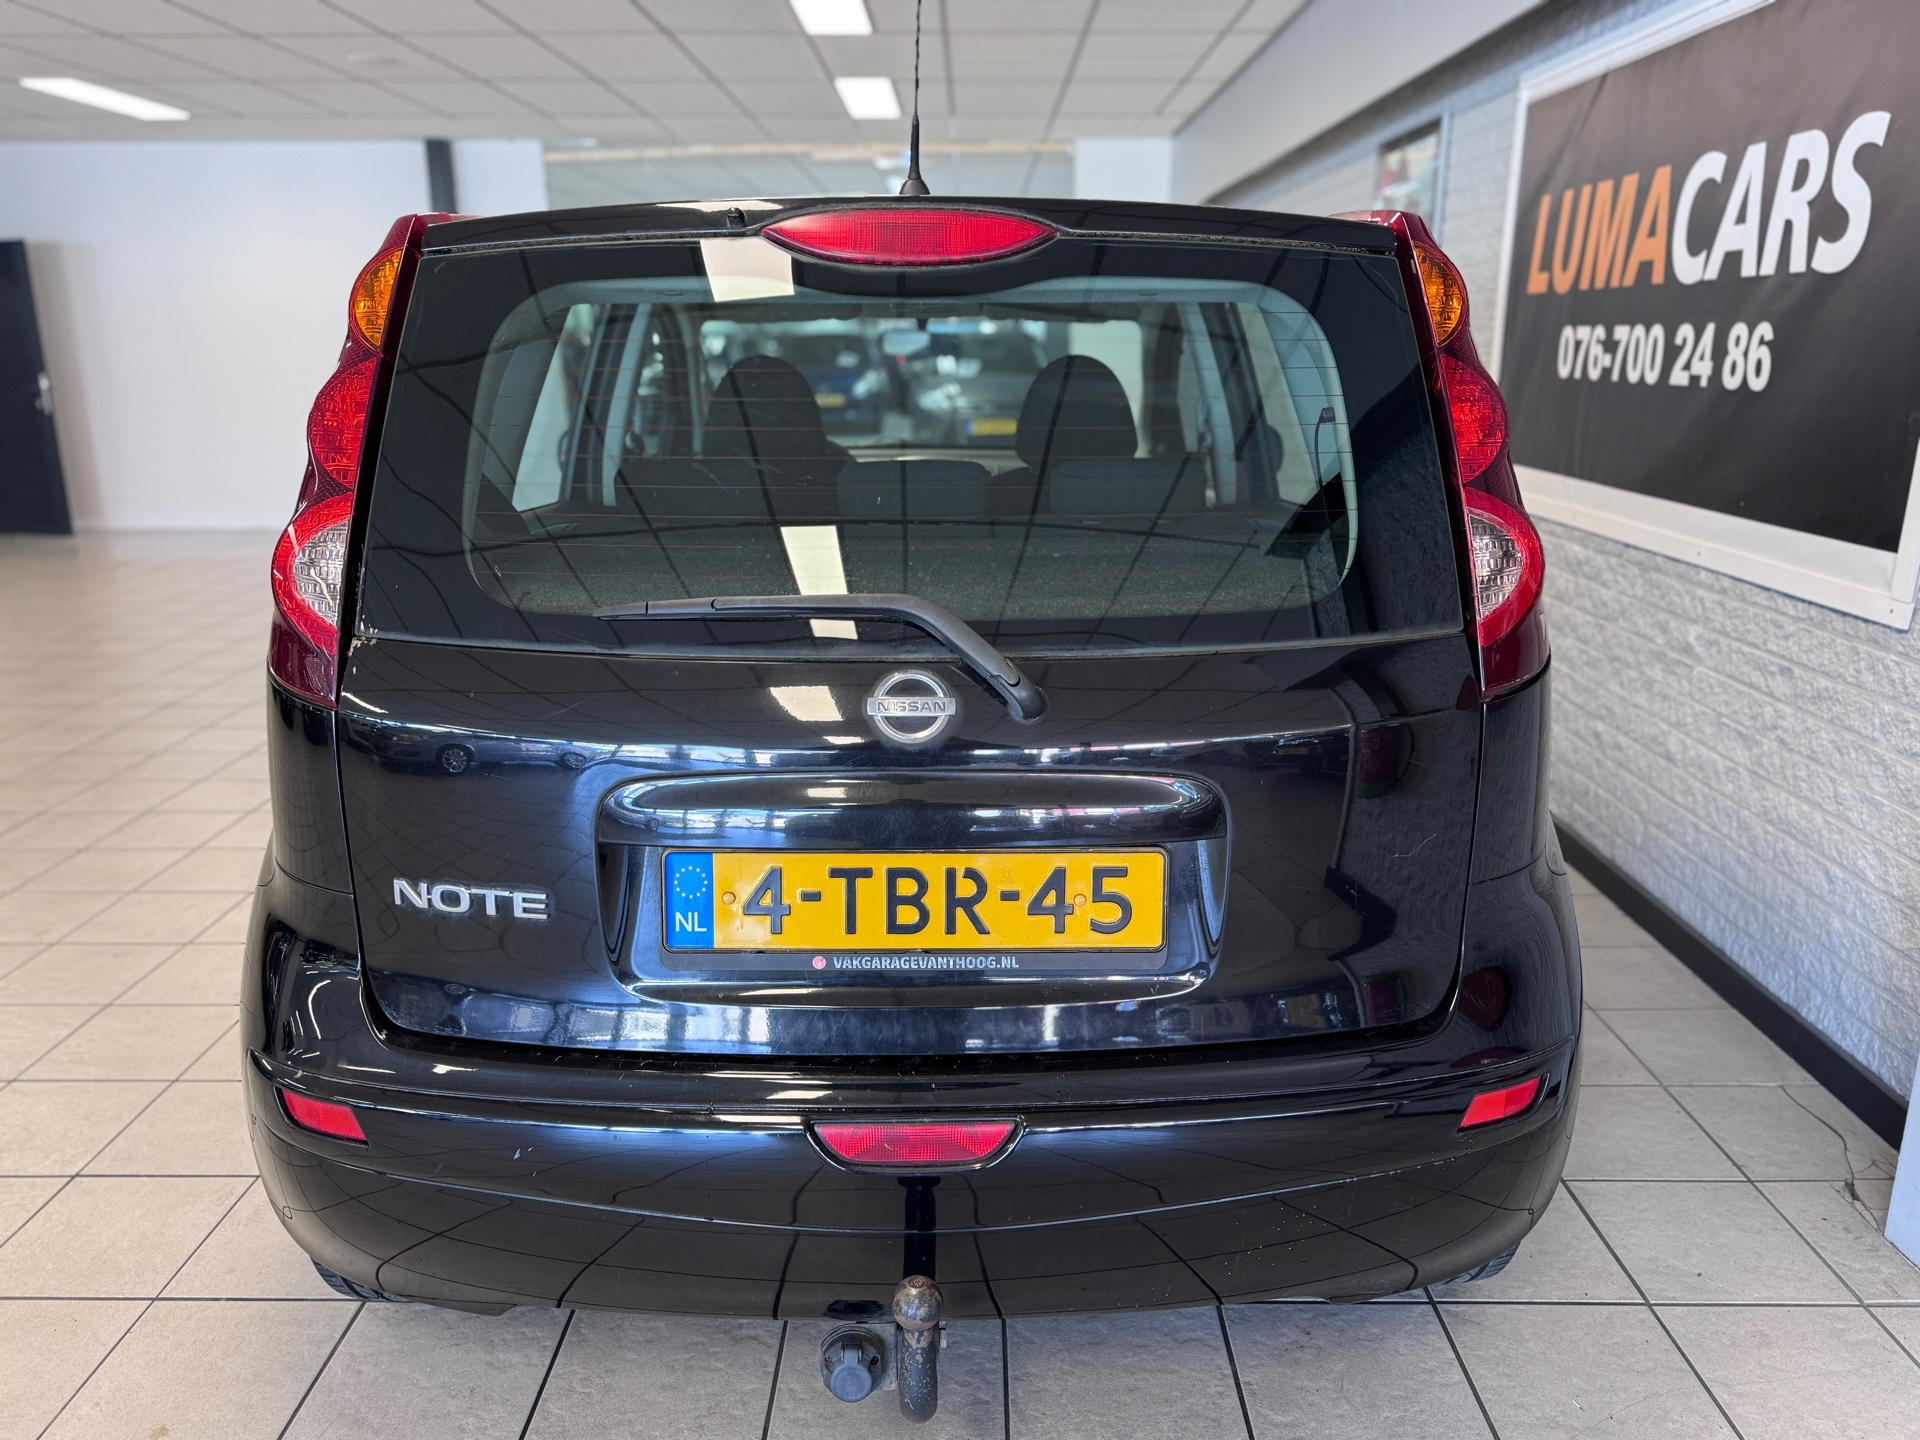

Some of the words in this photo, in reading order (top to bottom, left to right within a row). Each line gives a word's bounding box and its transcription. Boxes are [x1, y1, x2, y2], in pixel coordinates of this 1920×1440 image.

[1526, 111, 1891, 295] LUMACARS
[1557, 323, 1665, 385] 076-700
[1668, 322, 1716, 387] 24
[1722, 321, 1774, 392] 86
[877, 701, 946, 712] NISSAN
[393, 878, 549, 920] NOTE
[742, 866, 1132, 935] 4-TBR-45
[675, 912, 707, 932] NL
[833, 956, 1019, 969] VAKGARAGEVANTHOOG.NL
